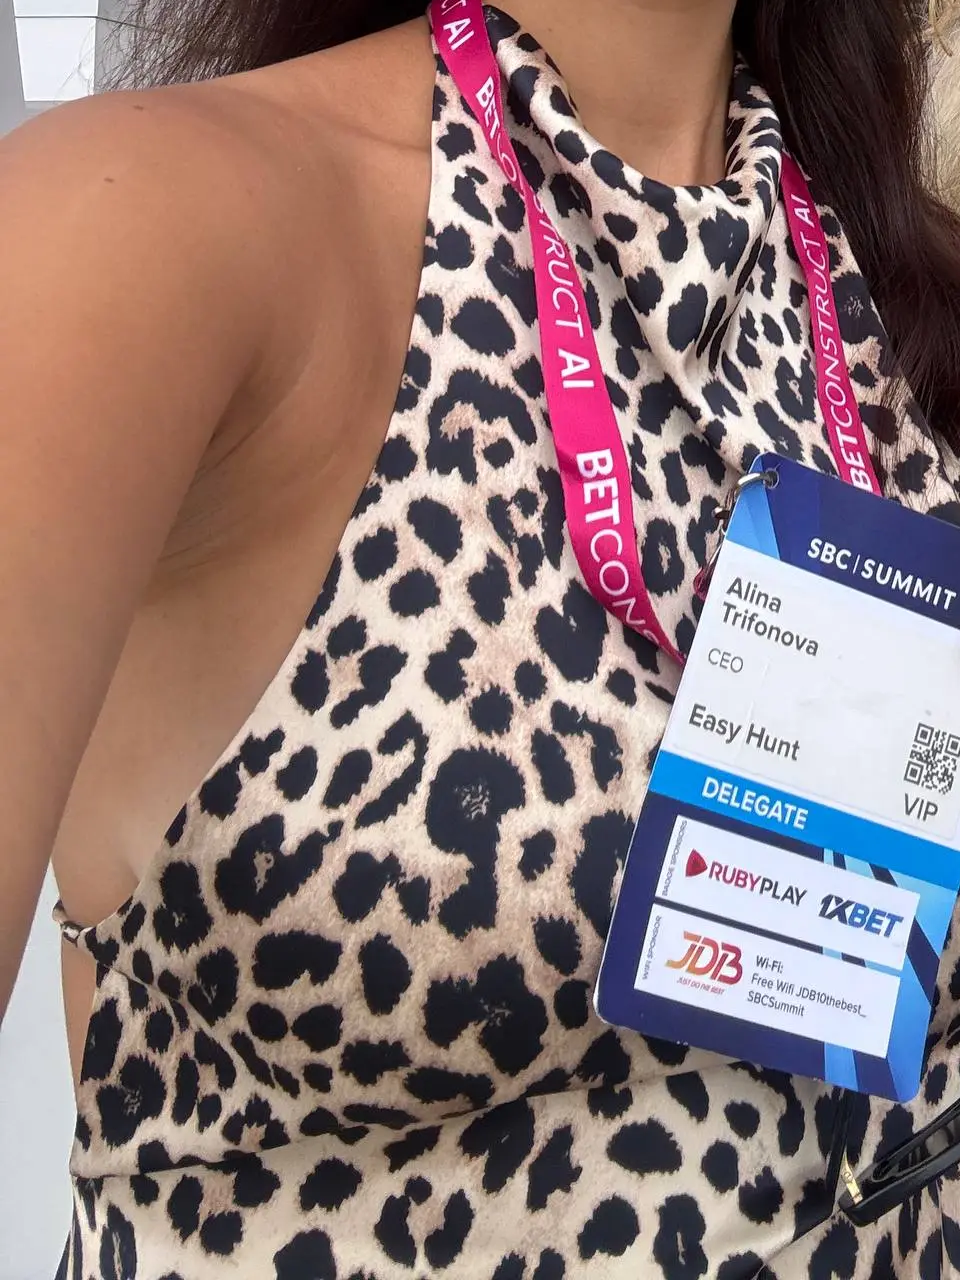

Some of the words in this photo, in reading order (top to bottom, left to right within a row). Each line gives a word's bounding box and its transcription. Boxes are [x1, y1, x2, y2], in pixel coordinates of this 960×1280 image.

[443, 18, 475, 51] AI
[791, 195, 815, 220] AI
[558, 348, 594, 389] AI
[800, 232, 873, 493] BETCONSTRUCT
[726, 576, 782, 614] Alina
[807, 537, 852, 572] SBC
[860, 558, 957, 612] SUMMIT
[721, 603, 819, 657] Trifonova
[707, 648, 744, 674] CEO
[688, 704, 742, 745] Easy
[747, 723, 800, 762] Hunt
[702, 777, 808, 831] DELEGATE
[903, 792, 939, 823] VIP
[709, 861, 807, 907] RUBYPLAY
[820, 893, 903, 939] 1XBET
[665, 931, 742, 985] JDB
[747, 990, 805, 1017] SBCSummit
[751, 973, 774, 989] Free
[776, 979, 795, 995] Wifi
